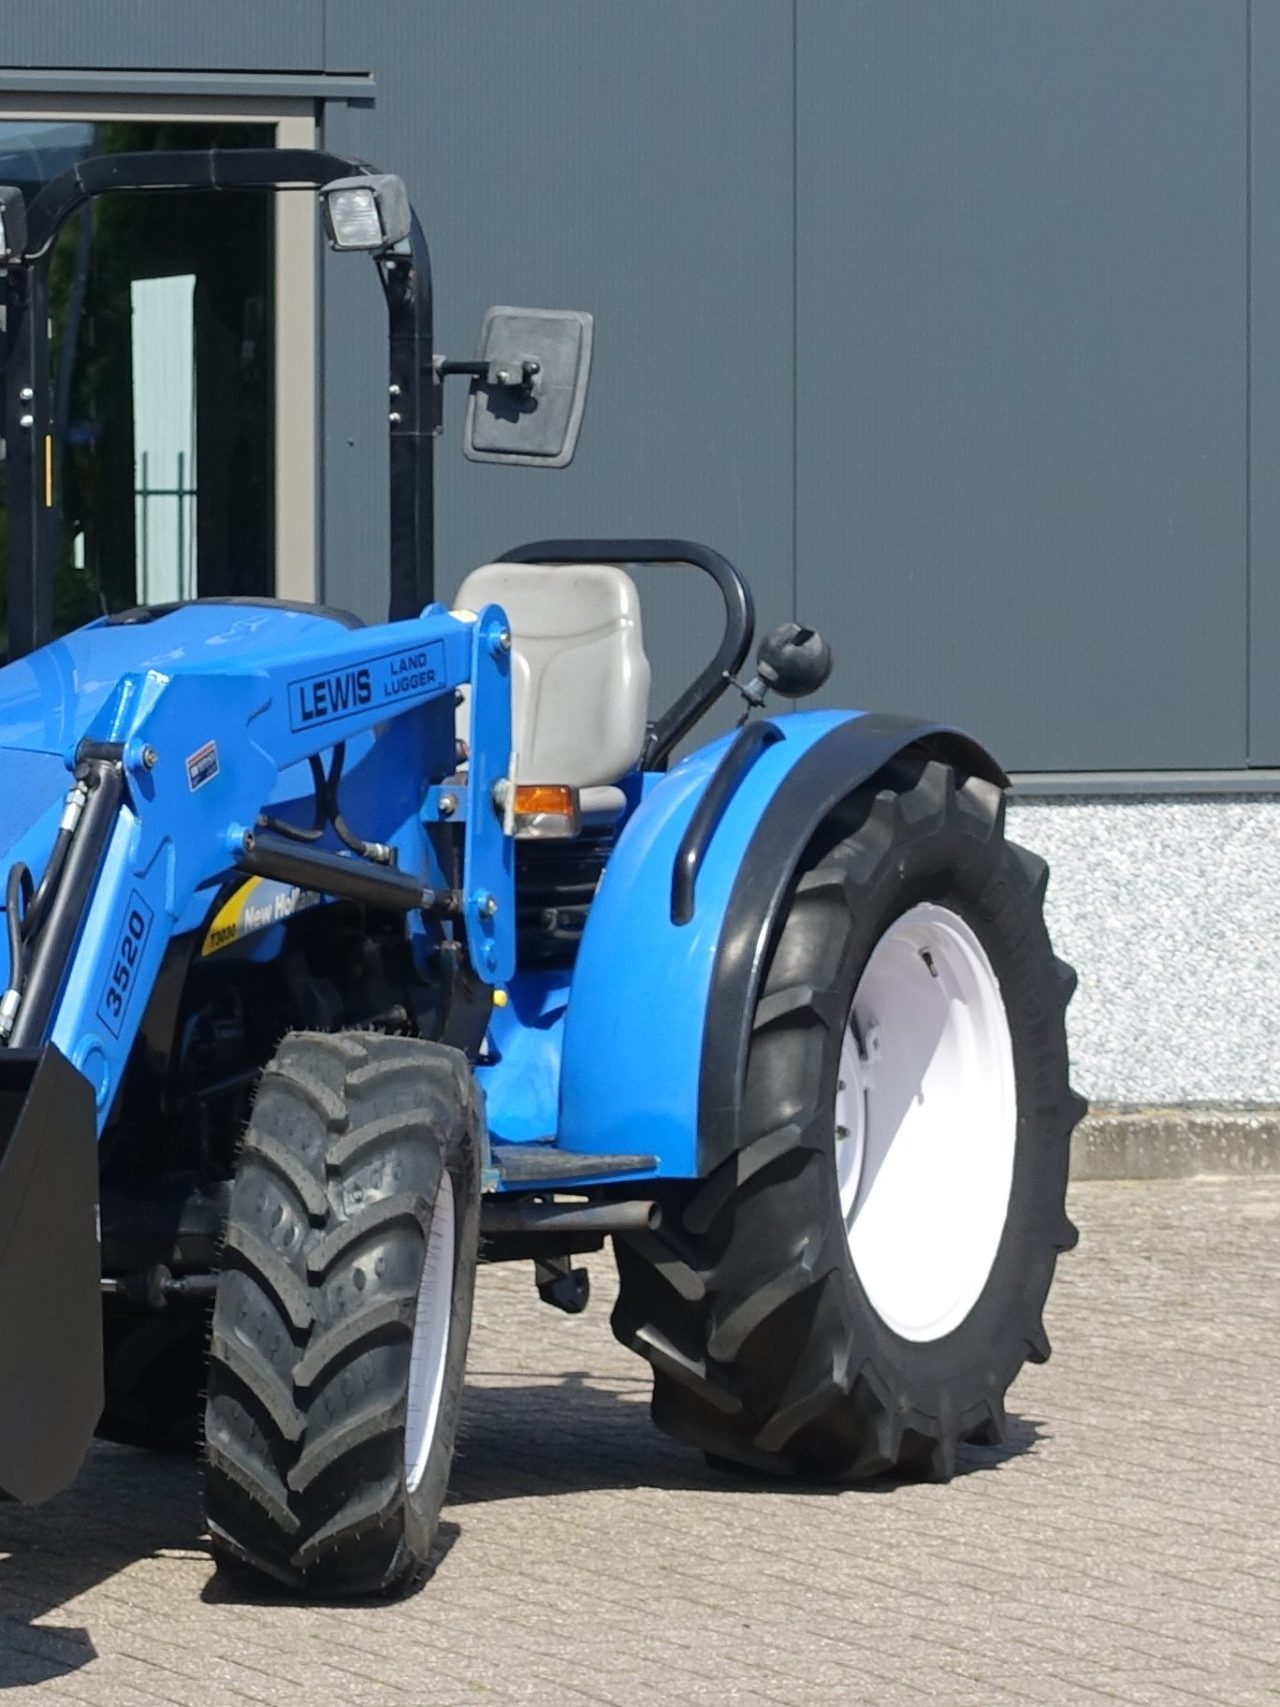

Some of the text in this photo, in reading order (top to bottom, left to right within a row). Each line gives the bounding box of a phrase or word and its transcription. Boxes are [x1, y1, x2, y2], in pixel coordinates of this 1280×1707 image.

[390, 653, 427, 676] LAND
[299, 668, 372, 721] LEWIS
[383, 669, 436, 698] LUGGER
[243, 904, 273, 933] New
[106, 909, 145, 1017] 3520
